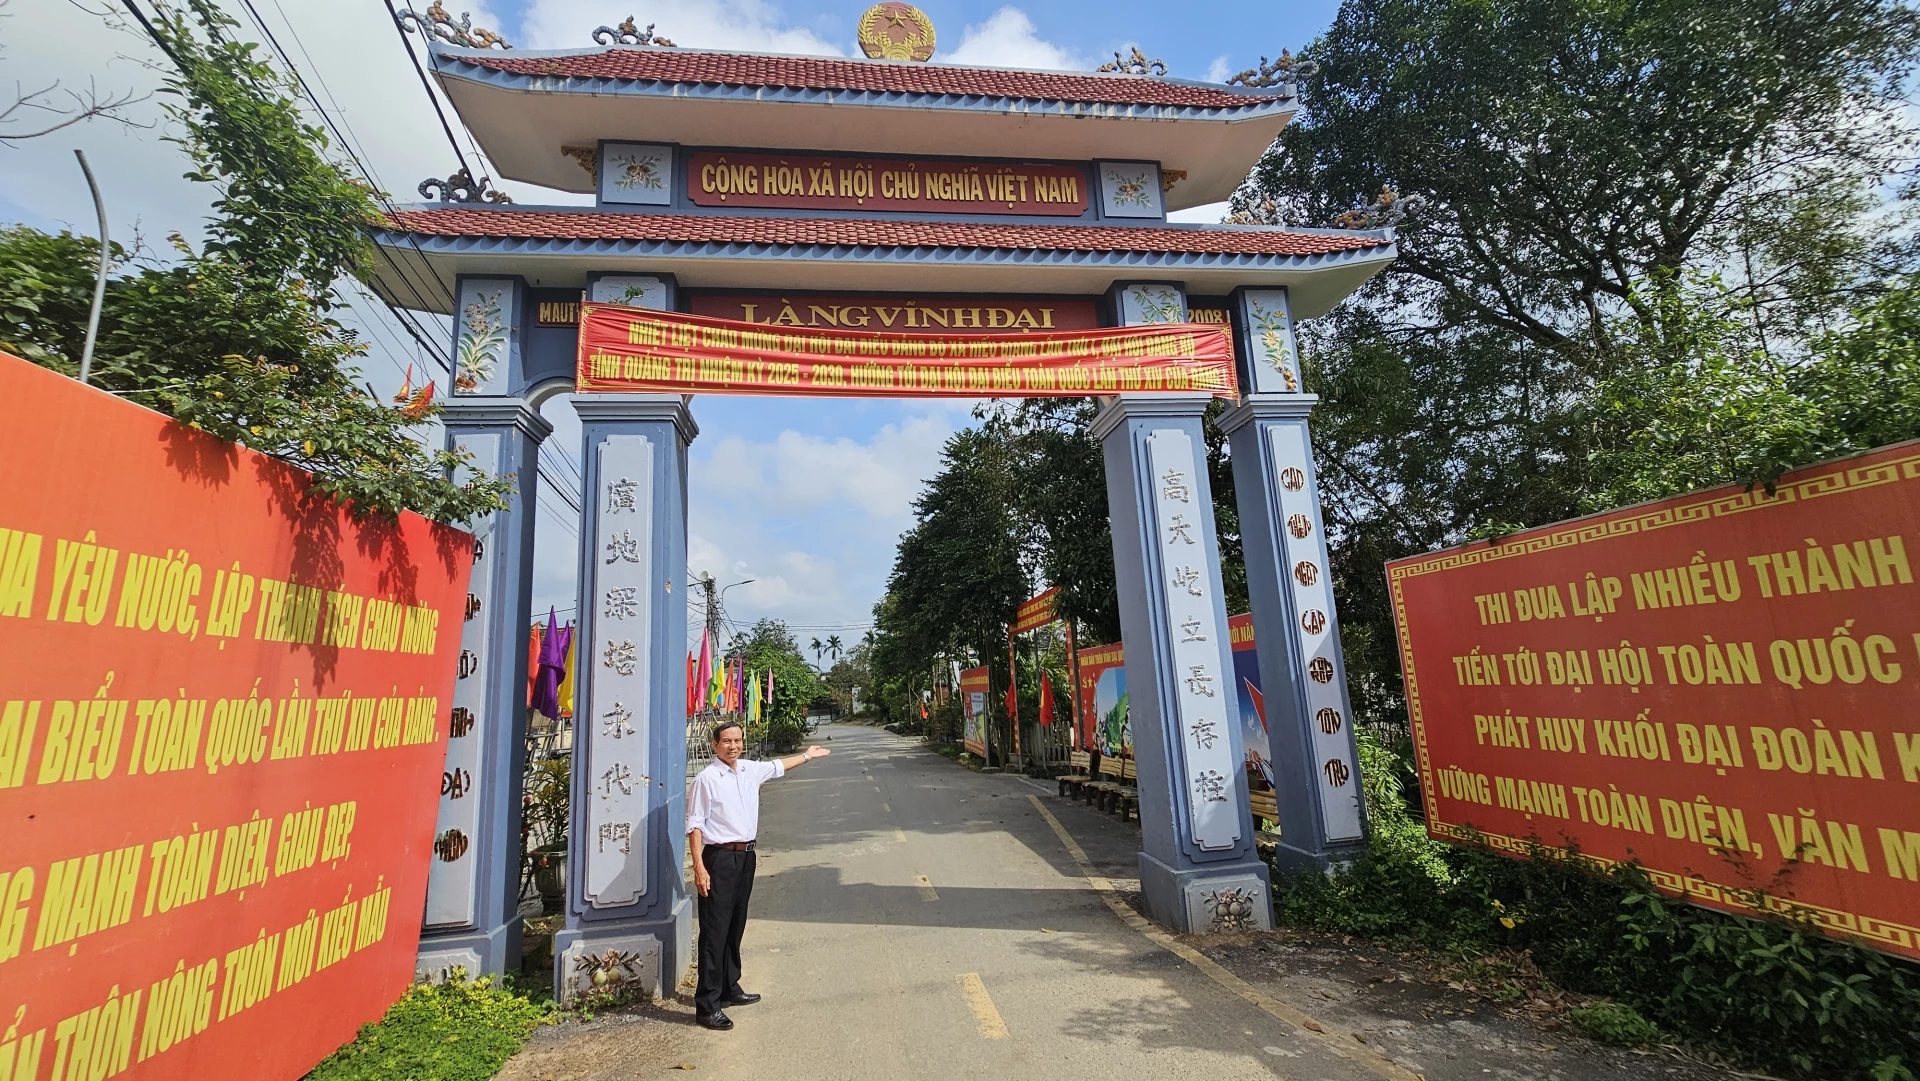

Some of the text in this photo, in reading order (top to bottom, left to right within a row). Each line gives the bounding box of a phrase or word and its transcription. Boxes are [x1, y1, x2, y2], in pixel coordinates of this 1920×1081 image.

[702, 157, 758, 200] CỘNG
[763, 160, 804, 196] HÒA
[808, 161, 835, 197] XÃ
[839, 163, 874, 205] HỘI
[881, 163, 920, 199] CHỦ
[985, 167, 1027, 209] VIỆT
[1034, 175, 1079, 203] NAM
[628, 320, 668, 351] NHIỆT
[671, 322, 700, 352] LIỆT
[702, 325, 737, 349] CHÀO
[741, 328, 780, 353] MỪNG
[784, 334, 805, 357] ĐẠI
[809, 333, 831, 357] HỘI
[835, 337, 856, 358] ĐẠI
[860, 332, 888, 355] BIỂU
[949, 338, 966, 357] XÃ
[1188, 309, 1223, 323] 2008
[590, 347, 621, 379] TỈNH
[624, 350, 671, 382] QUẢNG
[674, 357, 695, 387] TRỊ
[699, 356, 743, 387] NHIỆM
[747, 357, 765, 383] KỲ
[767, 363, 799, 385] 2025
[812, 364, 847, 388] 2030,
[850, 360, 893, 388] HƯỚNG
[896, 361, 917, 389] TỚI
[920, 366, 942, 392] ĐẠI
[944, 362, 965, 393] HỘI
[968, 366, 990, 393] ĐẠI
[992, 359, 1021, 390] BIỂU
[1022, 362, 1056, 390] TOÀN
[1058, 361, 1091, 392] QUỐC
[1092, 360, 1117, 390] LẦN
[1119, 360, 1142, 389] THỨ
[1144, 366, 1163, 390] XIV
[1165, 359, 1189, 390] CỦA
[47, 530, 119, 626] YÊU
[115, 549, 202, 642] NƯỚC,
[205, 561, 255, 650] LẬP
[254, 573, 323, 645] THÀNH
[321, 584, 364, 649] TÍCH
[361, 594, 402, 652] CHÀO
[400, 600, 439, 656] MỪNG
[1475, 536, 1915, 626] THI ĐUA LẬP NHIỀU THÀNH
[1452, 645, 1501, 686] TIẾN
[1503, 646, 1542, 685] TỚI
[1546, 650, 1593, 693] ĐẠI
[1598, 640, 1652, 694] HỘI
[1657, 635, 1763, 685] TOÀN
[1769, 618, 1903, 691] QUỐC
[37, 671, 129, 785] BIỂU
[129, 695, 207, 775] TOÀN
[204, 677, 272, 775] QUỐC
[270, 678, 312, 760] LẦN
[310, 690, 353, 756] THỨ
[344, 698, 377, 752] XIV
[373, 685, 404, 750] CỦA
[1474, 709, 1530, 750] PHÁT
[1536, 717, 1587, 754] HUY
[1593, 707, 1672, 762] KHỐI
[1676, 722, 1745, 776] ĐẠI
[1750, 718, 1885, 780] ĐOÀN
[1437, 764, 1493, 806] VỮNG
[1495, 776, 1570, 824] MẠNH
[1572, 785, 1656, 836] TOÀN
[1660, 794, 1764, 860] DIỆN,
[1767, 807, 1871, 874] VĂN
[32, 844, 145, 957] MẠNH
[143, 812, 219, 918] TOÀN
[214, 809, 273, 902] DIỆN,
[274, 800, 325, 878] GIÀU
[321, 800, 357, 870] ĐẸP,
[50, 983, 143, 1081] THÔN
[137, 958, 218, 1064] NÔNG
[219, 927, 281, 1021] THÔN
[276, 908, 320, 993] MỚI
[316, 883, 359, 973] KIỂU
[354, 874, 391, 952] MẪU
